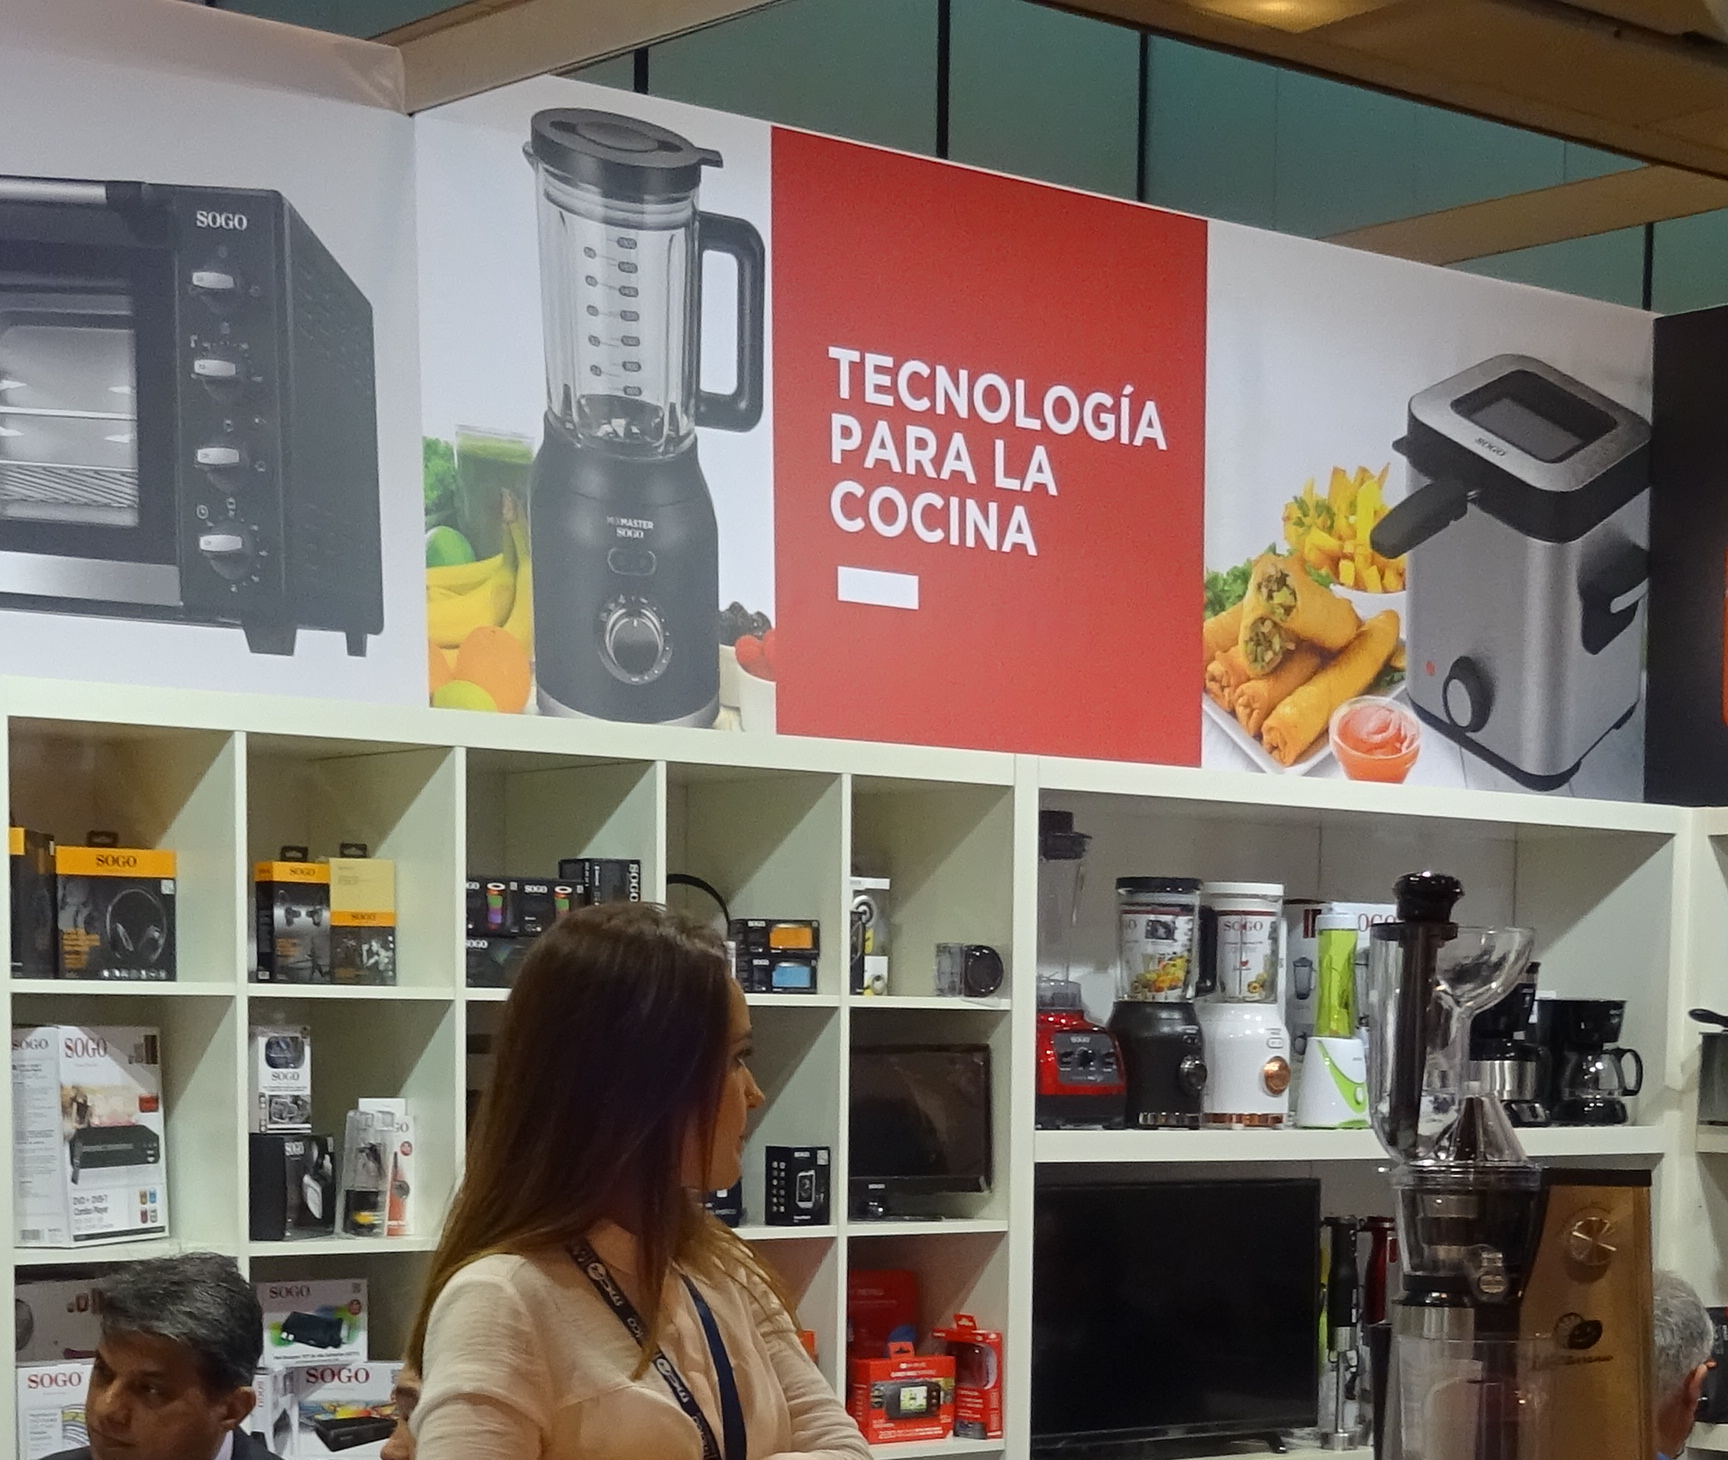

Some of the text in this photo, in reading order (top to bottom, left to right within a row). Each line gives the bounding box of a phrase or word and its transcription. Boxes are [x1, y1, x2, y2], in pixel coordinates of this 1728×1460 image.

[195, 210, 248, 232] SOGO
[828, 346, 1168, 451] TECNOLOGÍA
[829, 412, 1058, 497] PARA LA
[1474, 435, 1509, 458] SOGO
[828, 479, 1039, 557] COCINA
[95, 853, 138, 869] SOGO
[288, 866, 316, 878] SOGO
[524, 884, 548, 893] SOGO
[12, 1039, 49, 1050] SOGO
[64, 1037, 108, 1059] SOGO
[271, 1071, 300, 1082] SOGO
[284, 1142, 304, 1156] SOGO
[269, 1285, 311, 1299] SOGO
[27, 1371, 82, 1389] SOGO
[305, 1366, 371, 1384] SOGO
